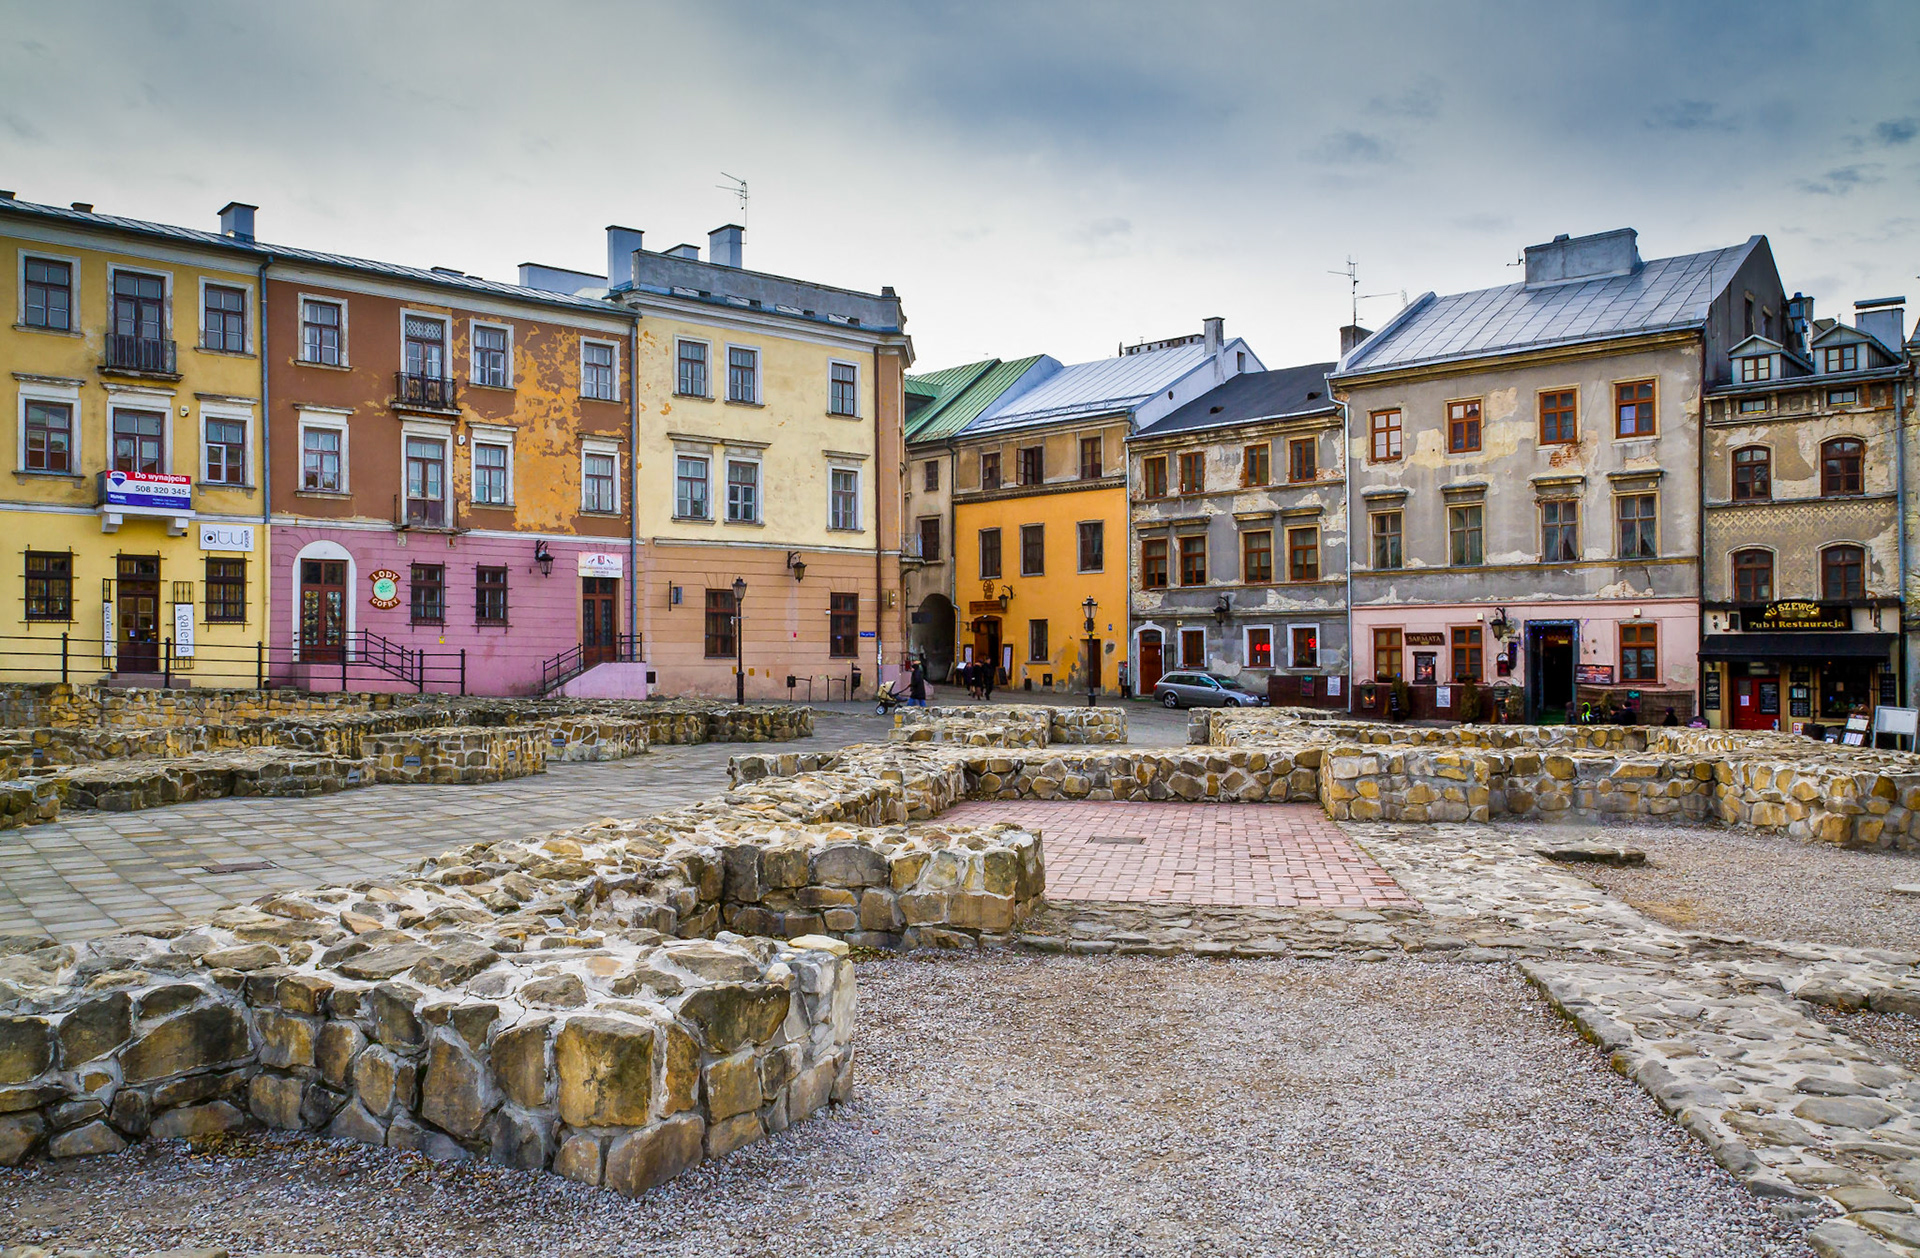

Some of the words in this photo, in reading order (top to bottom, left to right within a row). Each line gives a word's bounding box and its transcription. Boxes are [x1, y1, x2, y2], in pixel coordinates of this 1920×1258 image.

[135, 485, 151, 493] 508
[154, 486, 169, 494] 320
[372, 571, 398, 580] LODY
[1778, 619, 1845, 628] Restauracja
[177, 614, 191, 653] galera
